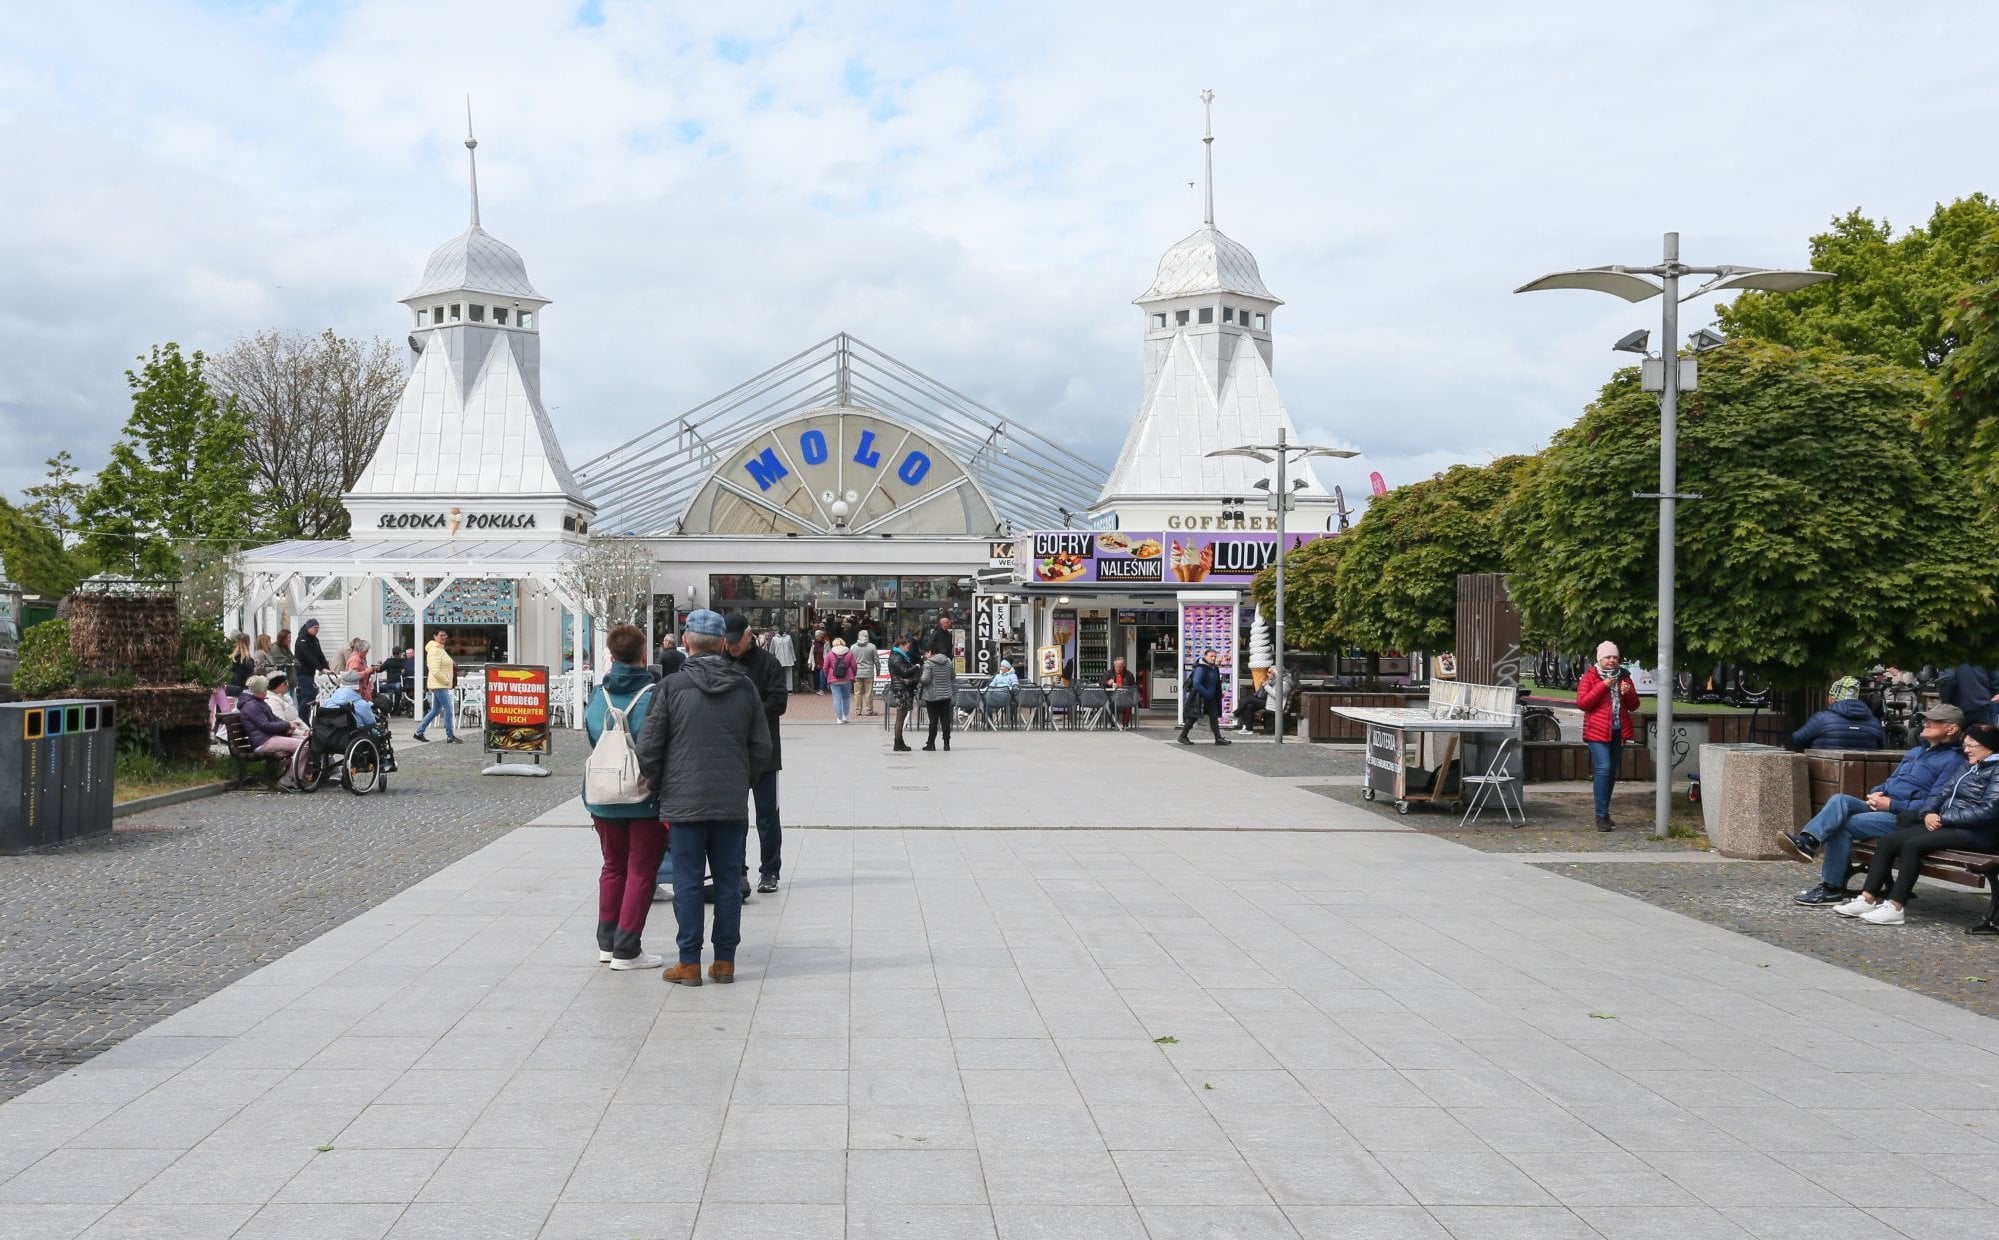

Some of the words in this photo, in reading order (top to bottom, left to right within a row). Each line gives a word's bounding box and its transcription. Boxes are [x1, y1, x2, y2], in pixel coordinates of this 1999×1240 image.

[744, 429, 931, 492] MOLO
[377, 513, 446, 529] SŁODKA
[466, 513, 536, 529] POKUSA
[1168, 515, 1277, 530] GOFEREK
[1036, 533, 1090, 555] GOFRY
[1214, 540, 1275, 570] LODY
[1100, 559, 1161, 577] NALEŚNIKI
[977, 597, 991, 674] KANTOR
[488, 682, 508, 693] RYBY
[509, 683, 546, 694] WĘDZONE
[494, 694, 501, 705] U
[502, 695, 539, 706] GRUBEGO
[490, 706, 544, 716] GERAUCHERTER
[506, 716, 527, 724] FISCH
